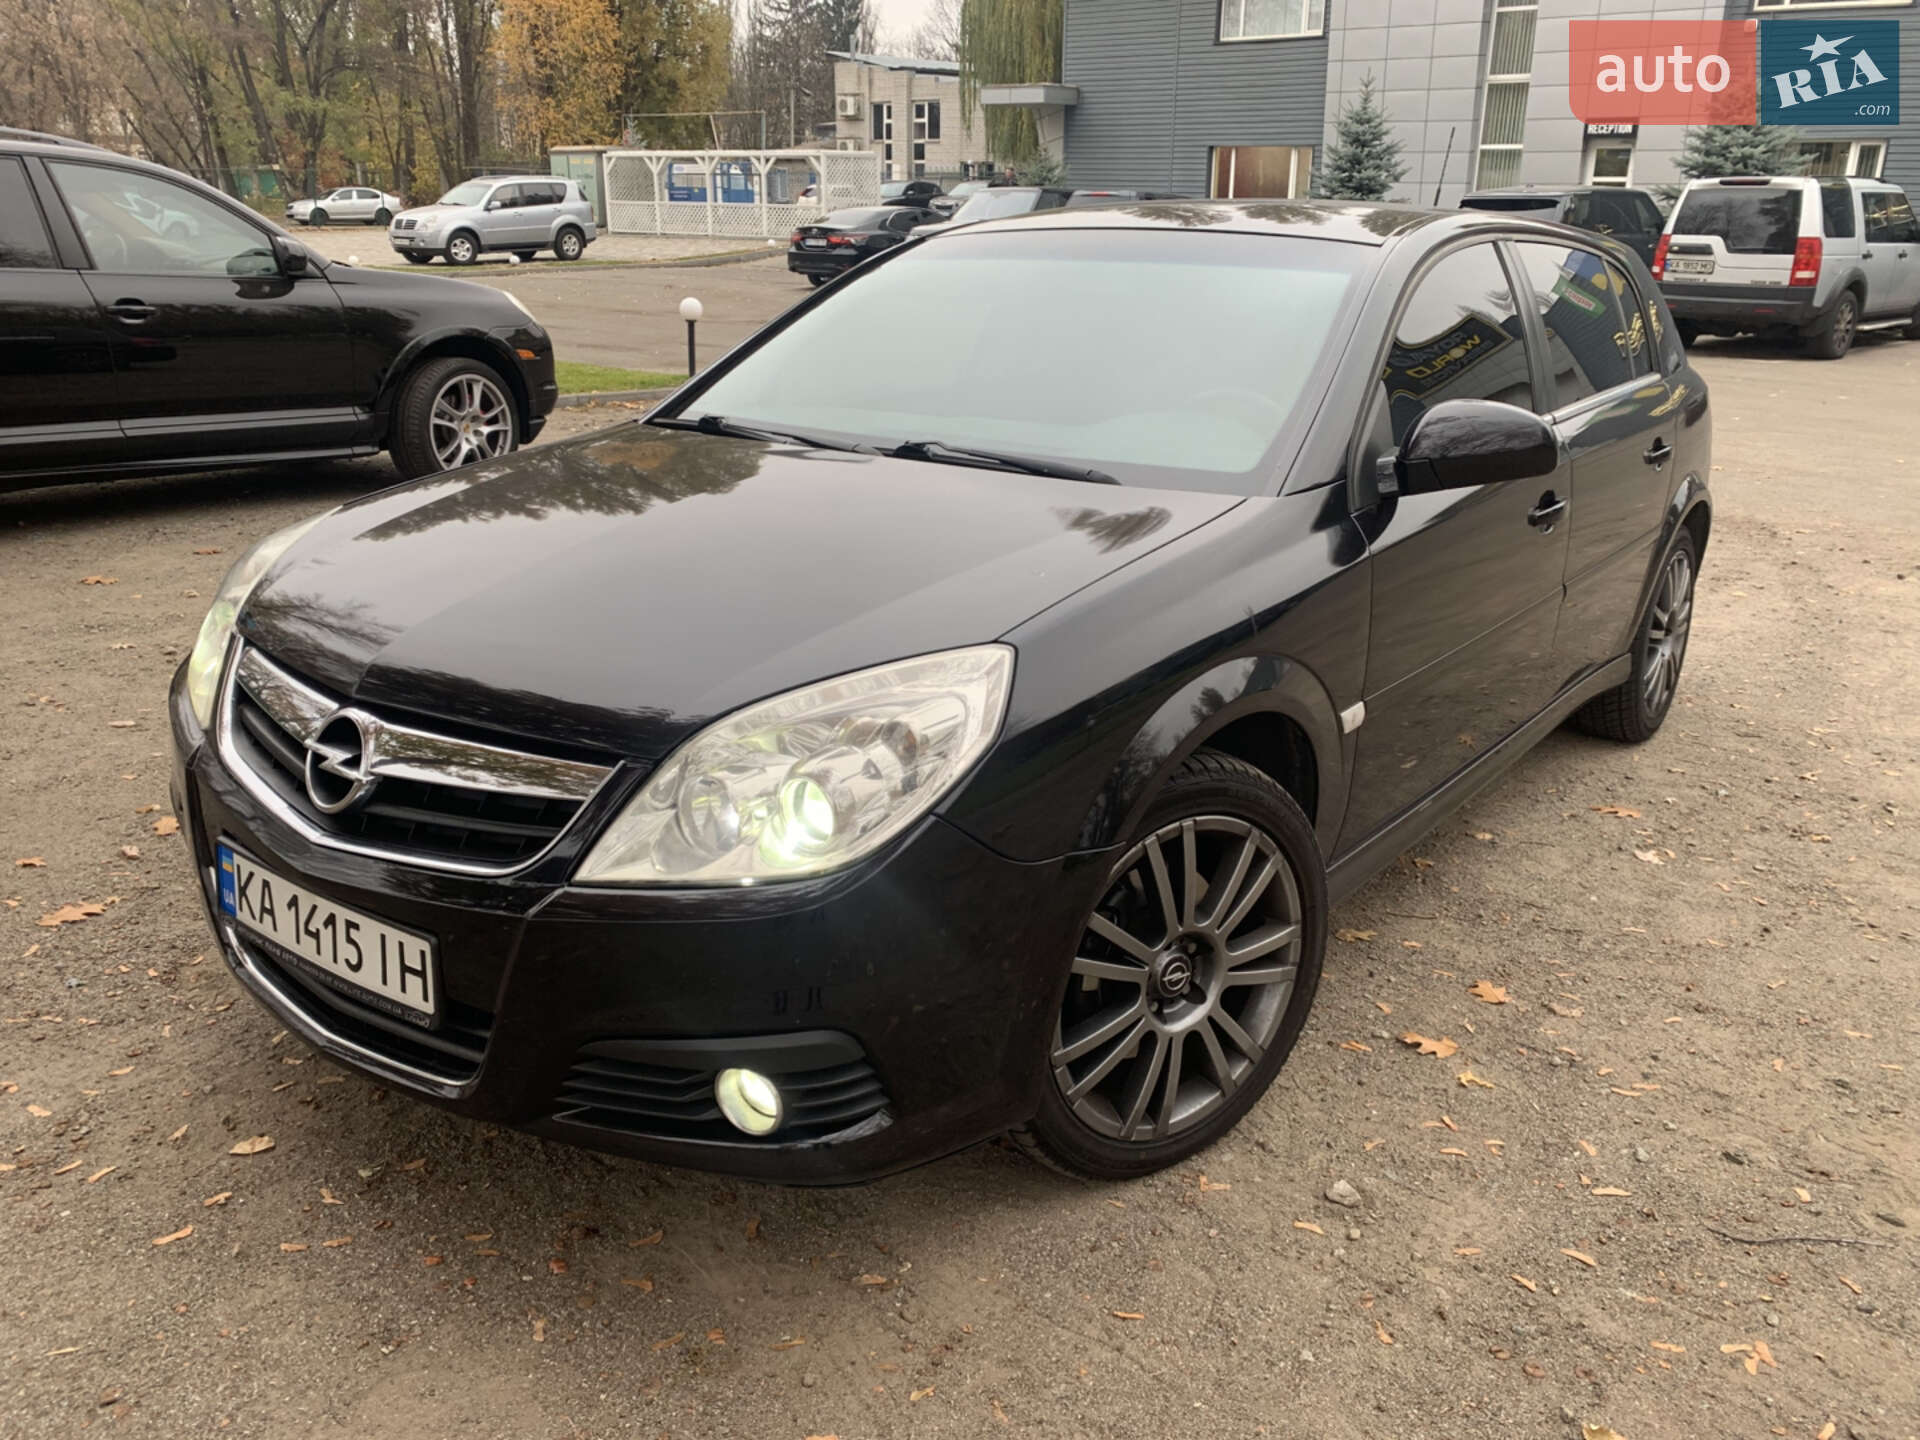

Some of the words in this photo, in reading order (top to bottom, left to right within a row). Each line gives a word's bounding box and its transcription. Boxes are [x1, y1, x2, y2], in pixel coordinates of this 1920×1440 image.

[223, 887, 235, 906] UA
[236, 863, 278, 932] KA
[286, 893, 363, 973] 1415
[380, 932, 430, 1003] IH
